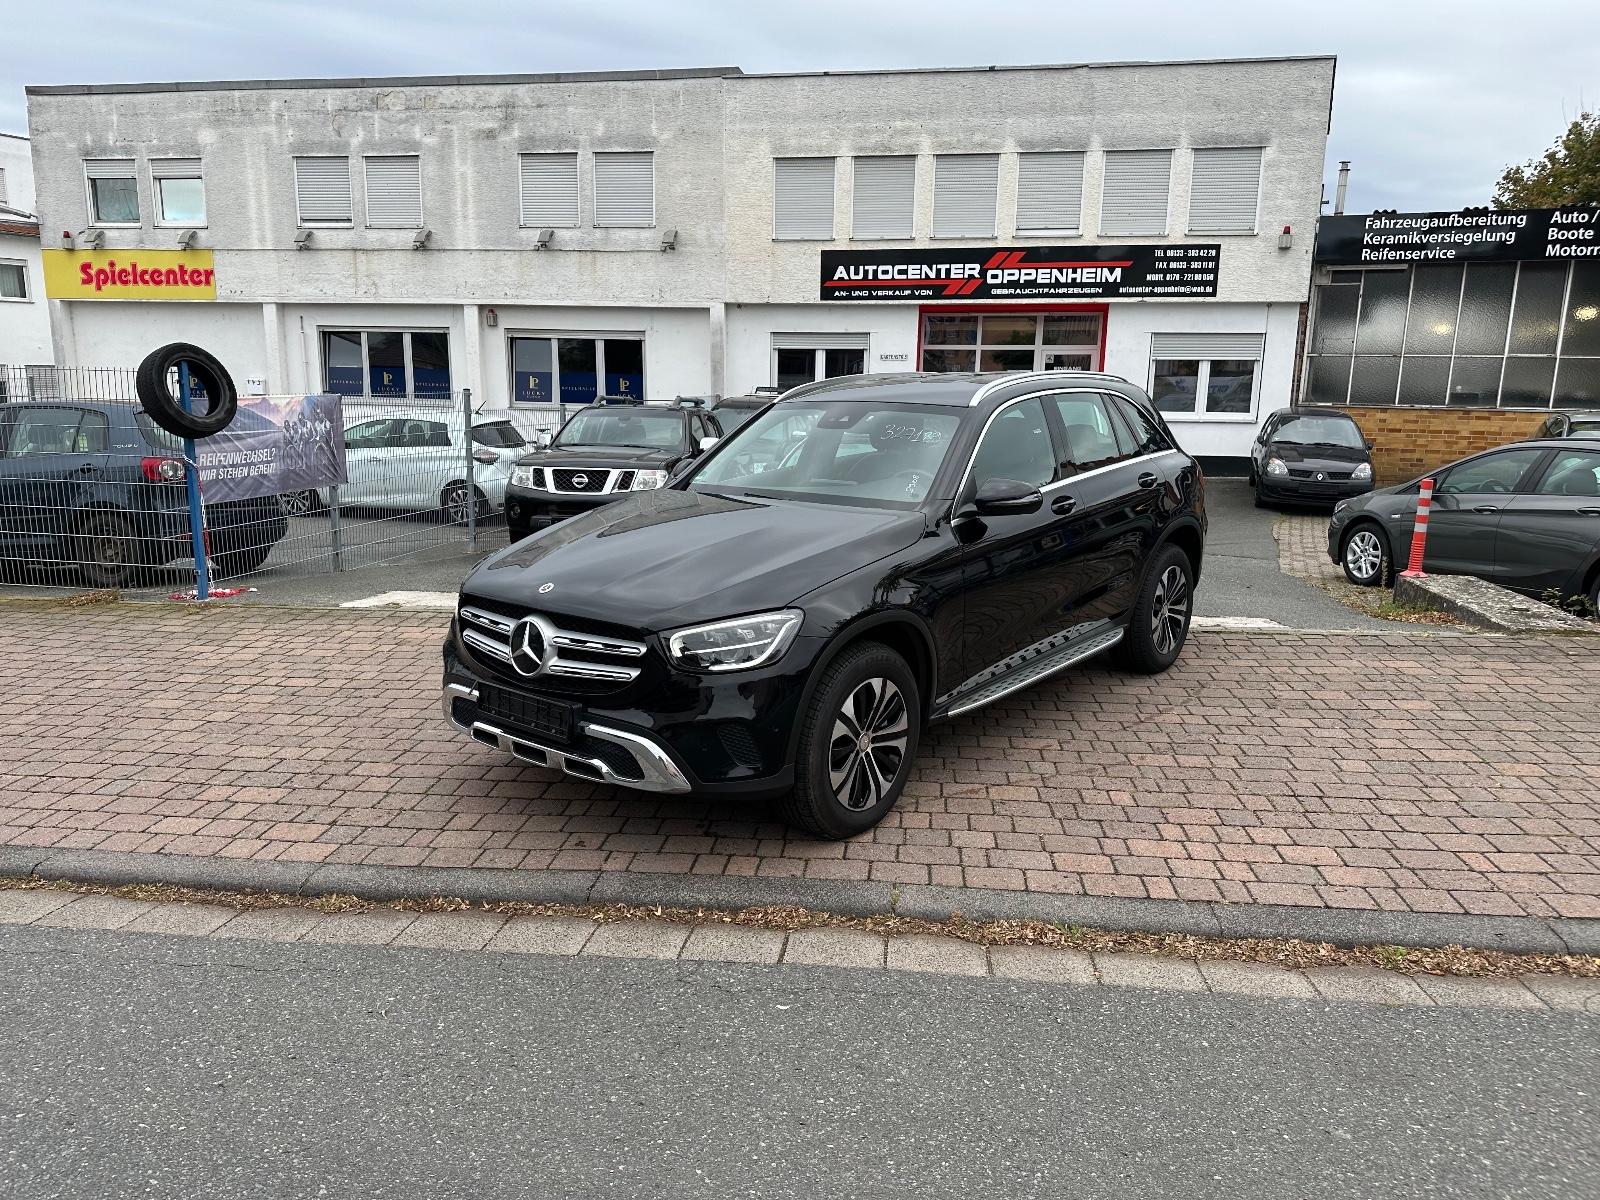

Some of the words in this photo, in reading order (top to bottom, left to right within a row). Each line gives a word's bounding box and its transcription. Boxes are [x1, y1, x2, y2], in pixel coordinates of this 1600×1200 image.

[1365, 213, 1527, 229] Fahrzeugaufbereitung
[1550, 211, 1589, 223] Auto
[1363, 229, 1516, 245] Keramikversiegelung
[1547, 227, 1594, 240] Boote
[1154, 249, 1164, 257] TEL
[1361, 247, 1456, 261] Reifenservice
[1545, 244, 1600, 257] Motorr
[833, 264, 980, 280] AUTOCENTER
[1155, 261, 1167, 269] FAX
[79, 260, 215, 291] Spielcenter
[987, 268, 1122, 284] OPPENHEIM
[991, 287, 1103, 295] GEBRAUCHTFAHRZEUGEN
[200, 448, 276, 467] REIFENWECHSEL?
[199, 468, 216, 481] WIR
[218, 466, 249, 480] STEHEN
